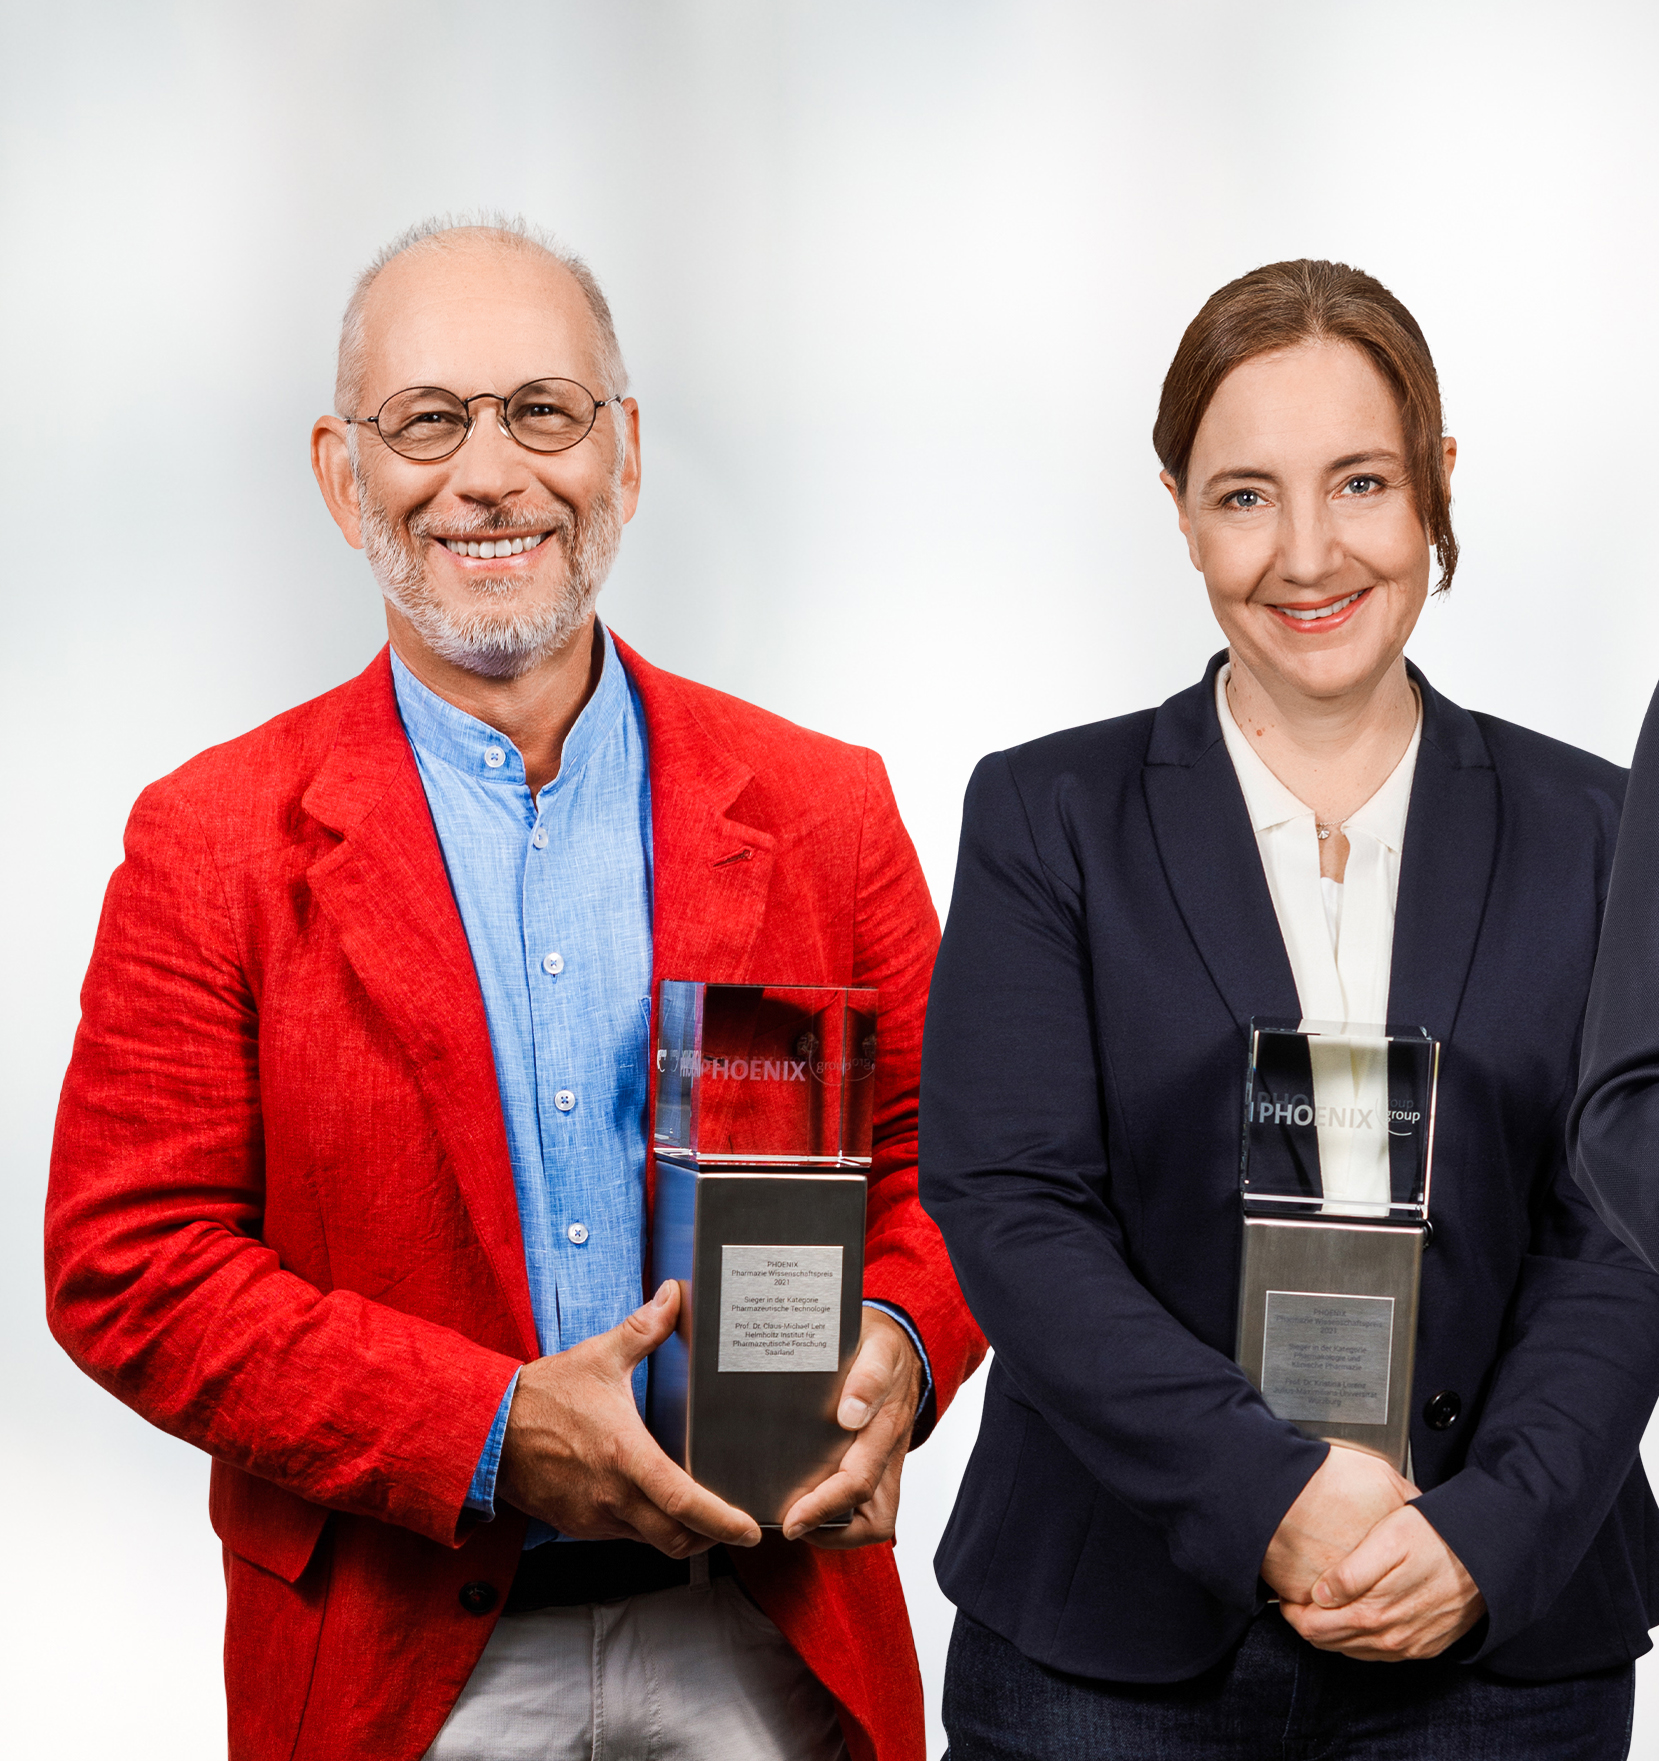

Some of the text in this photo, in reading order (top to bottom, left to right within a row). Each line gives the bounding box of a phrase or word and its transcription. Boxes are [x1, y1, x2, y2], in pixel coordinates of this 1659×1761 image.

[701, 1058, 806, 1081] PHOENIX
[1259, 1102, 1373, 1129] PHOENIX
[1386, 1110, 1420, 1124] group
[769, 1270, 833, 1278] Wissenschaftspreis
[744, 1296, 765, 1304] Sieger
